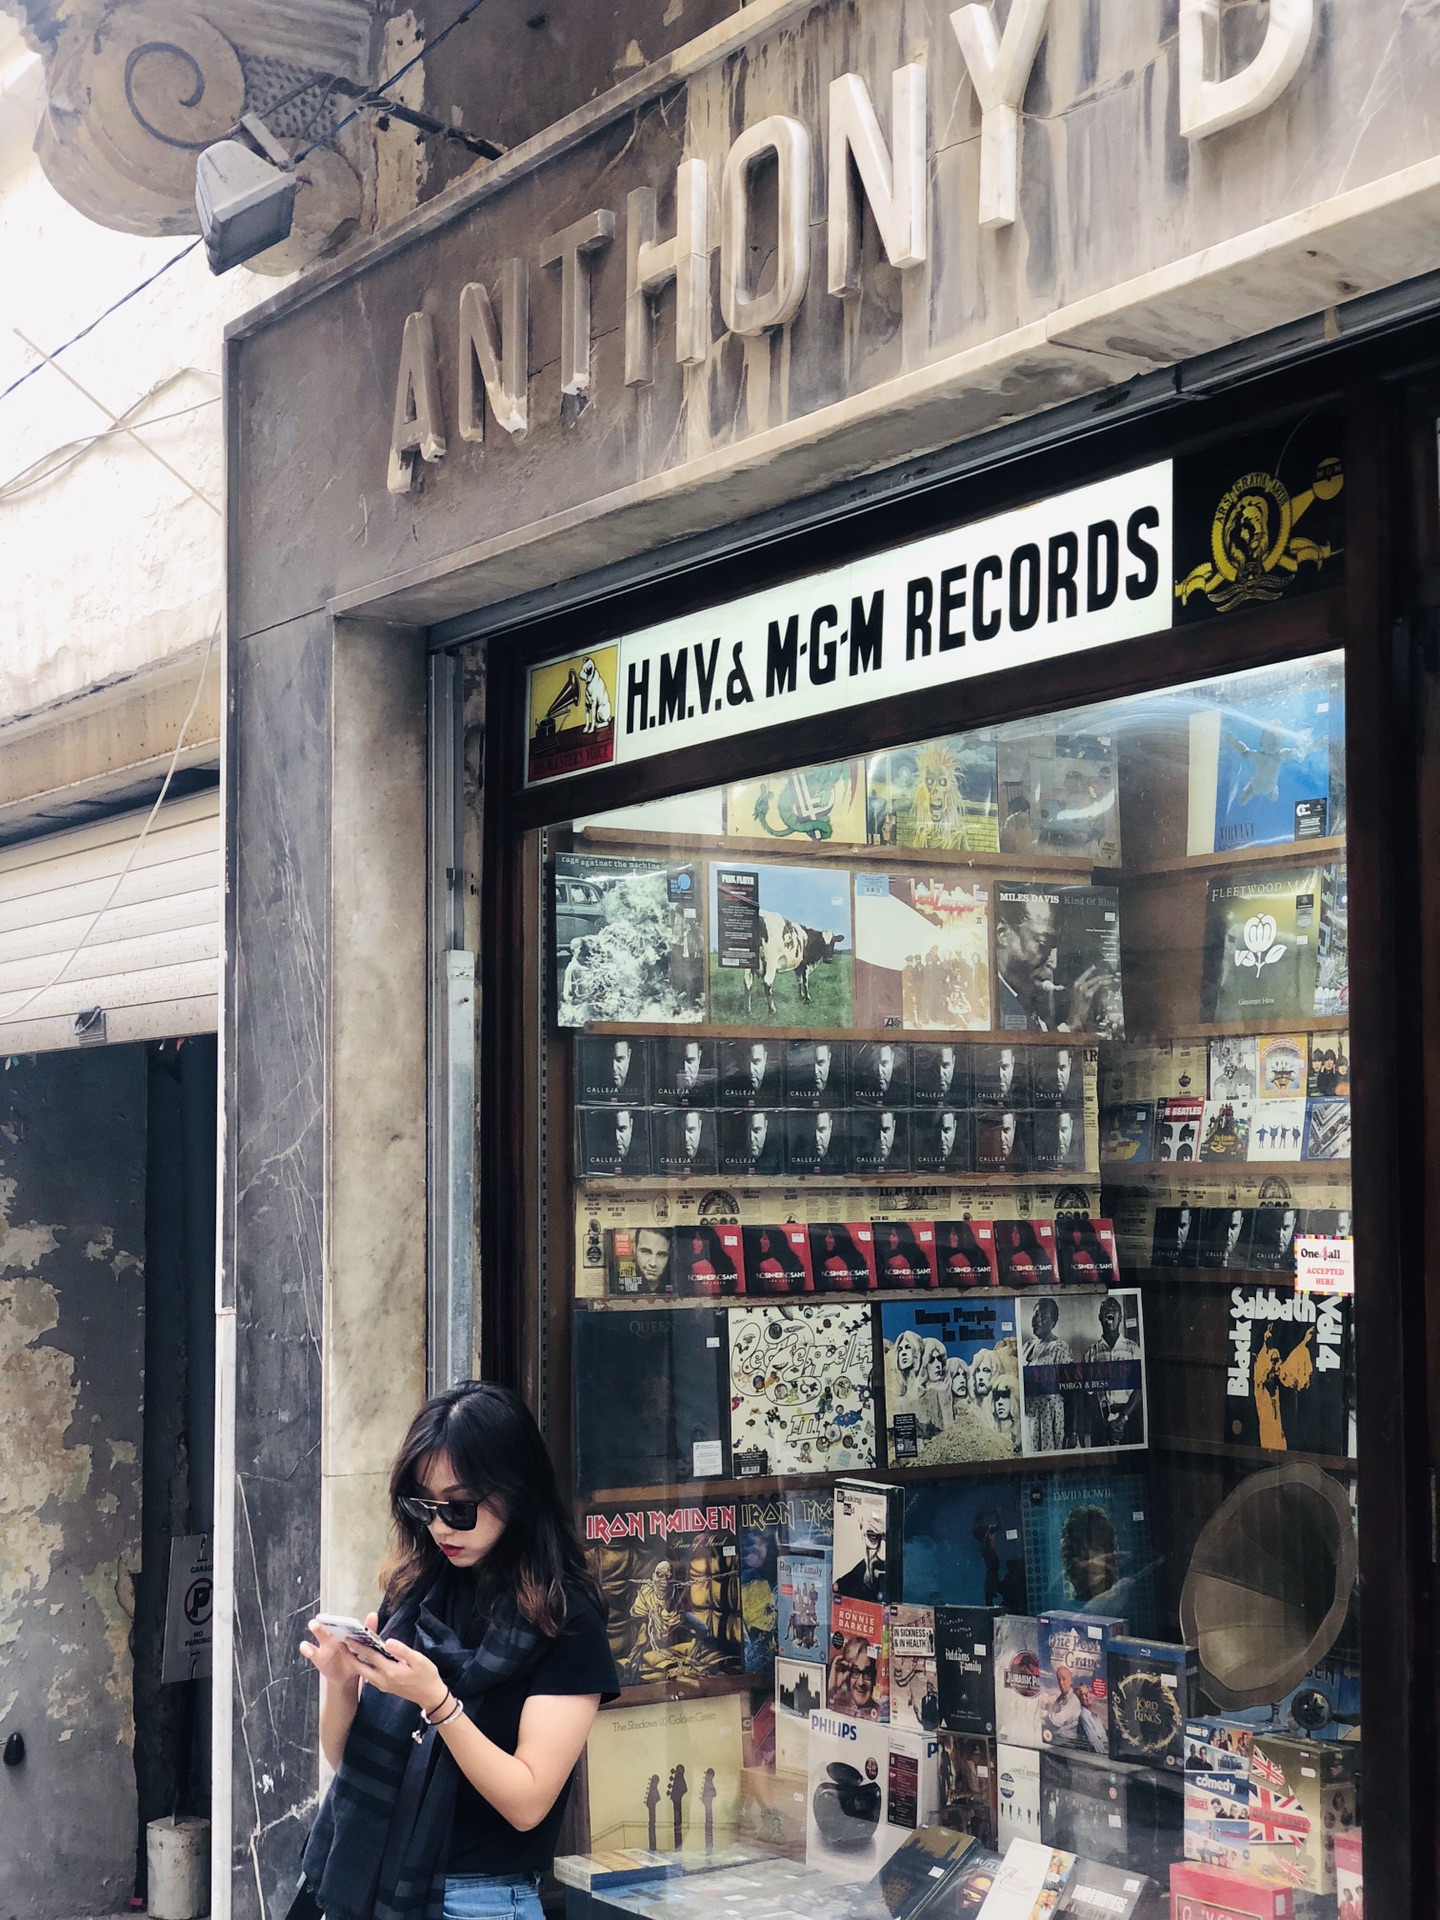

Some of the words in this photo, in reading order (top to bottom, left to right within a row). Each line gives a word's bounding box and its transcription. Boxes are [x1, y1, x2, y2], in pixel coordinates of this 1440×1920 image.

[387, 0, 1052, 495] ANTHONY
[906, 505, 1160, 662] RECORDS
[561, 856, 579, 865] rage
[581, 858, 612, 868] against
[629, 862, 661, 870] machine
[1211, 881, 1282, 902] FLEETWOOD
[999, 892, 1029, 903] MILES
[1031, 894, 1060, 904] DAVIS
[1064, 896, 1084, 906] Kind
[586, 1086, 619, 1094] CALLEJA
[1172, 1106, 1202, 1116] BEATLES
[1306, 1267, 1345, 1276] ACCEPTED
[1315, 1277, 1336, 1286] HERE
[1226, 1319, 1252, 1397] Black
[1058, 1381, 1083, 1391] PORGY
[1084, 1381, 1091, 1390] &
[1091, 1380, 1109, 1389] BESS
[837, 1491, 863, 1505] Breaking
[741, 1500, 795, 1532] IRON
[844, 1503, 855, 1515] Bad
[586, 1511, 646, 1546] IRON
[647, 1505, 737, 1542] MAIDEN
[190, 1564, 213, 1575] GARAG
[799, 1562, 823, 1578] Family
[838, 1610, 875, 1626] RONNIE
[838, 1618, 875, 1634] BARKER
[900, 1628, 926, 1638] SICKNESS
[193, 1629, 204, 1638] NO
[899, 1639, 905, 1647] IN
[906, 1639, 926, 1648] HEALTH
[1065, 1651, 1101, 1669] Grave
[960, 1659, 982, 1676] Family
[1133, 1709, 1162, 1725] RINGS
[612, 1721, 627, 1732] The
[627, 1718, 658, 1730] Shadows
[811, 1714, 857, 1741] PHILIPS
